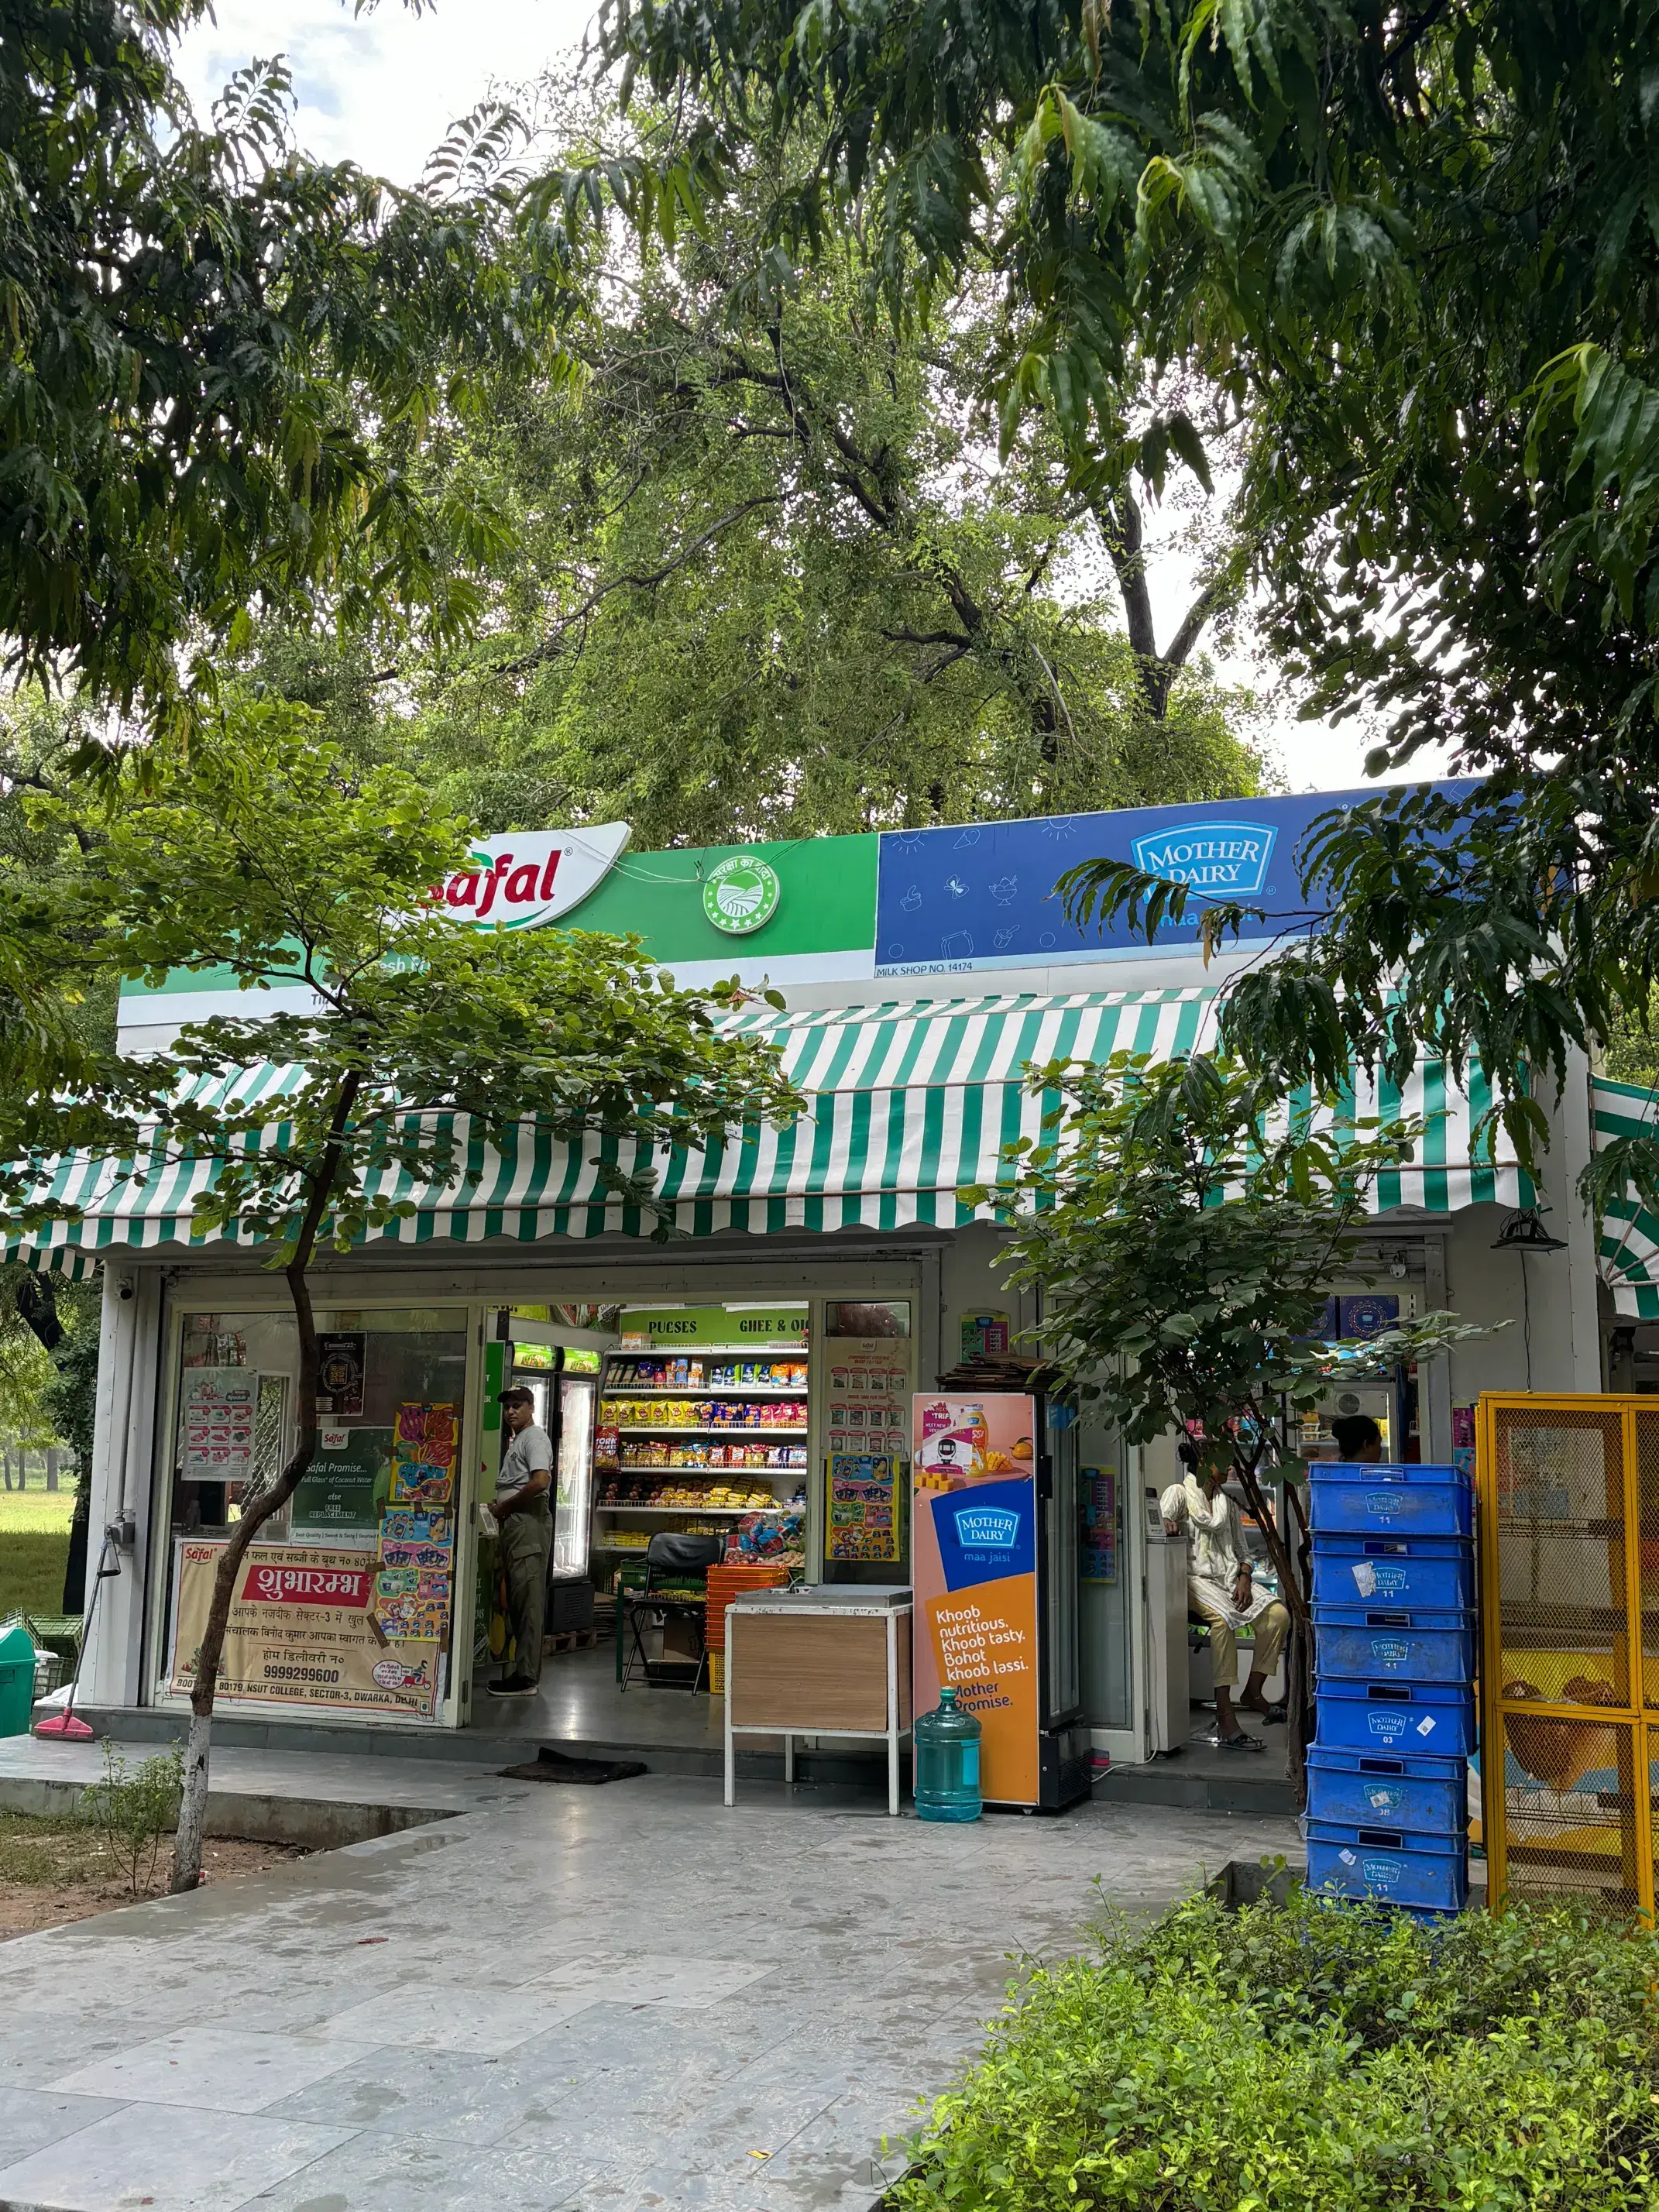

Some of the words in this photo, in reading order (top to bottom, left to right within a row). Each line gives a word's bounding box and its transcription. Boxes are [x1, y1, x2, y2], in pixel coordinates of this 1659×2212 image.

[740, 858, 754, 867] का
[1147, 840, 1260, 872] MOTHER
[1168, 864, 1242, 886] DAIRY
[877, 968, 898, 977] MILK
[900, 965, 927, 975] SHOP
[929, 964, 945, 973] NO.
[948, 962, 973, 972] 14174
[739, 1319, 773, 1332] GHEE
[777, 1319, 786, 1331] &
[325, 1433, 345, 1444] Safal
[306, 1462, 327, 1474] Safal
[328, 1476, 335, 1485] of
[962, 1516, 1013, 1532] MOTHER
[1379, 1516, 1391, 1524] 11
[971, 1530, 1005, 1540] DAIRY
[185, 1547, 214, 1561] Safal
[252, 1551, 267, 1561] फल
[270, 1551, 284, 1564] एवं
[287, 1551, 307, 1563] सब्जी
[310, 1551, 319, 1563] के
[964, 1553, 986, 1561] maa
[988, 1551, 1011, 1564] jaisi
[256, 1569, 362, 1600] शुभारम्भ
[232, 1605, 258, 1618] आपके
[262, 1606, 292, 1619] नजदीक
[349, 1614, 365, 1628] खुल
[936, 1605, 981, 1624] Khoob
[261, 1625, 283, 1639] विनोद
[283, 1629, 307, 1643] कुमार
[309, 1630, 337, 1642] आपका
[338, 1633, 366, 1646] स्वागत
[939, 1618, 1009, 1640] nutritious.
[942, 1633, 986, 1653] Khoob
[989, 1629, 1026, 1646] tasty.
[263, 1647, 280, 1661] होम
[283, 1649, 326, 1664] डिलीवरी
[944, 1650, 987, 1667] Bohot
[263, 1665, 339, 1684] 9999299600
[946, 1664, 991, 1682] khoob
[993, 1656, 1029, 1675] lassi.
[219, 1682, 243, 1692] 80179
[247, 1685, 268, 1694] NSUT
[270, 1685, 307, 1698] COLLEGE,
[310, 1689, 352, 1702] SECTOR-3,
[354, 1693, 393, 1704] DWARKA,
[396, 1695, 418, 1707] DELHI
[954, 1681, 999, 1698] Mother
[955, 1695, 1014, 1712] Promise.
[1376, 1884, 1388, 1892] 11
